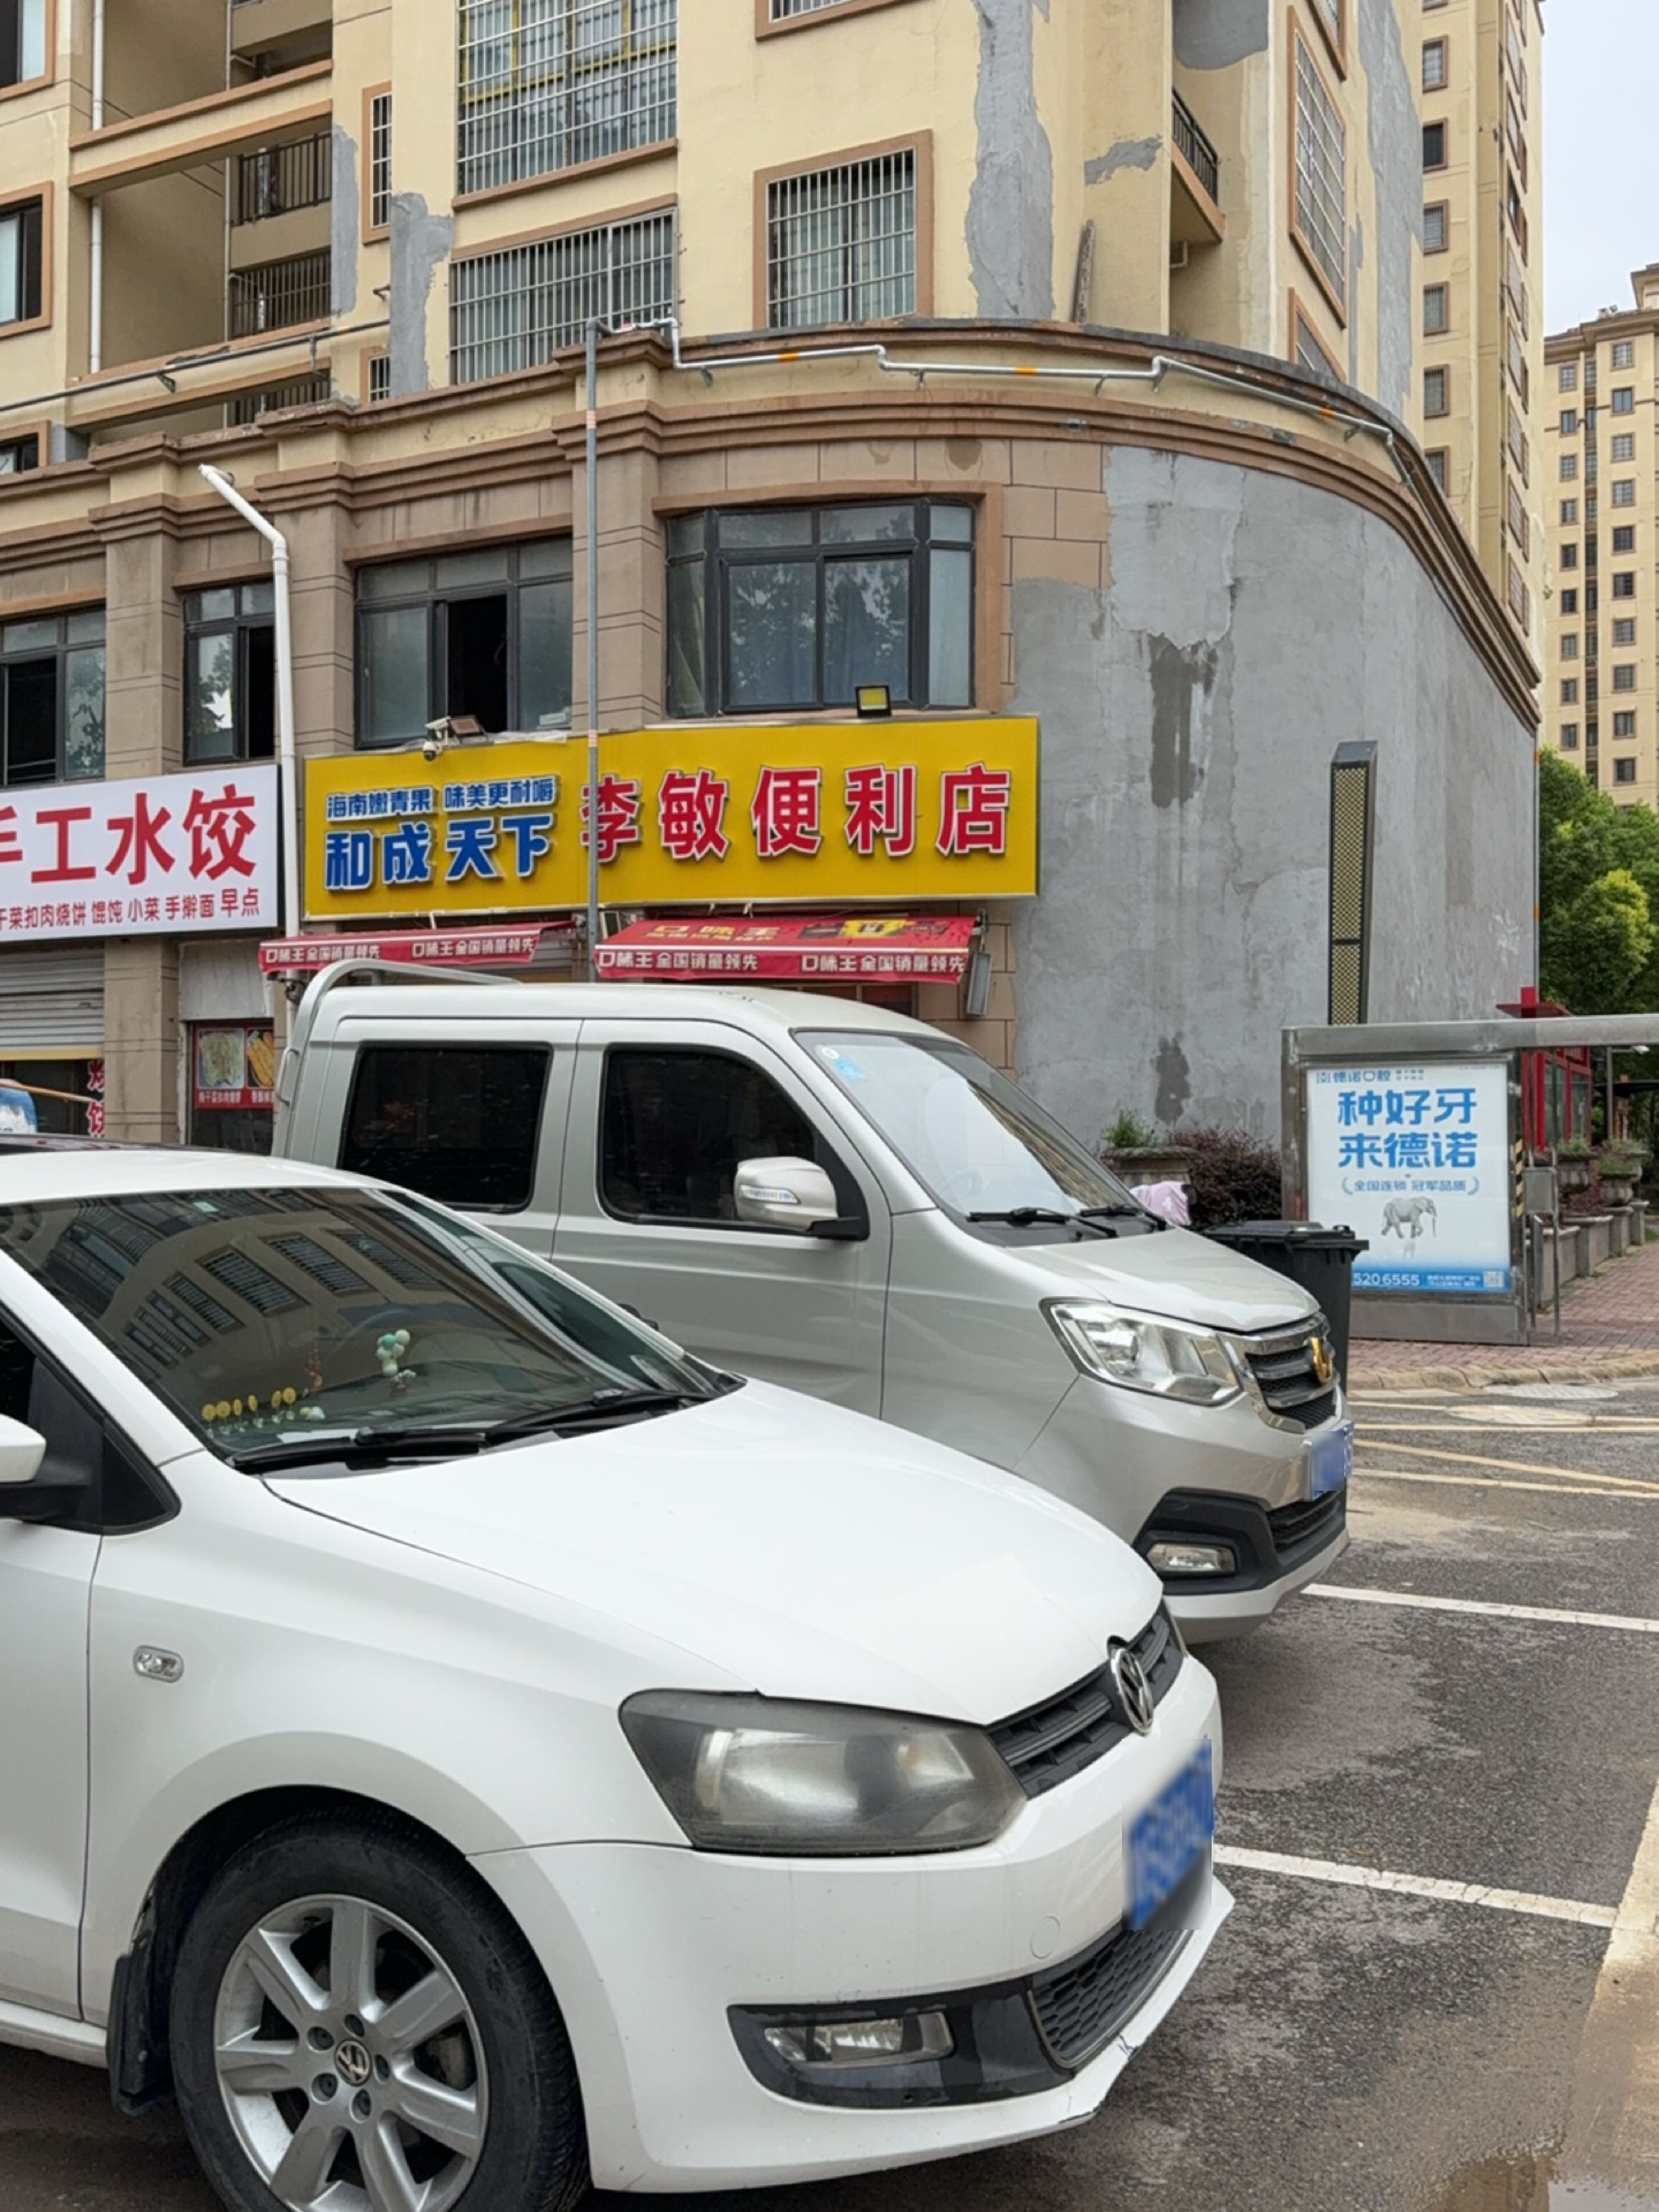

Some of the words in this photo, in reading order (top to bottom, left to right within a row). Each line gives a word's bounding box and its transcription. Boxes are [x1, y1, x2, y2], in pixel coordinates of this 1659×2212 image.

[580, 762, 1009, 862] 李敏便利店
[325, 813, 553, 890] 和成天下
[128, 897, 160, 922] 小菜
[221, 886, 259, 918] 早点
[1338, 1087, 1477, 1126] 种好牙
[1338, 1132, 1478, 1169] 来德诺
